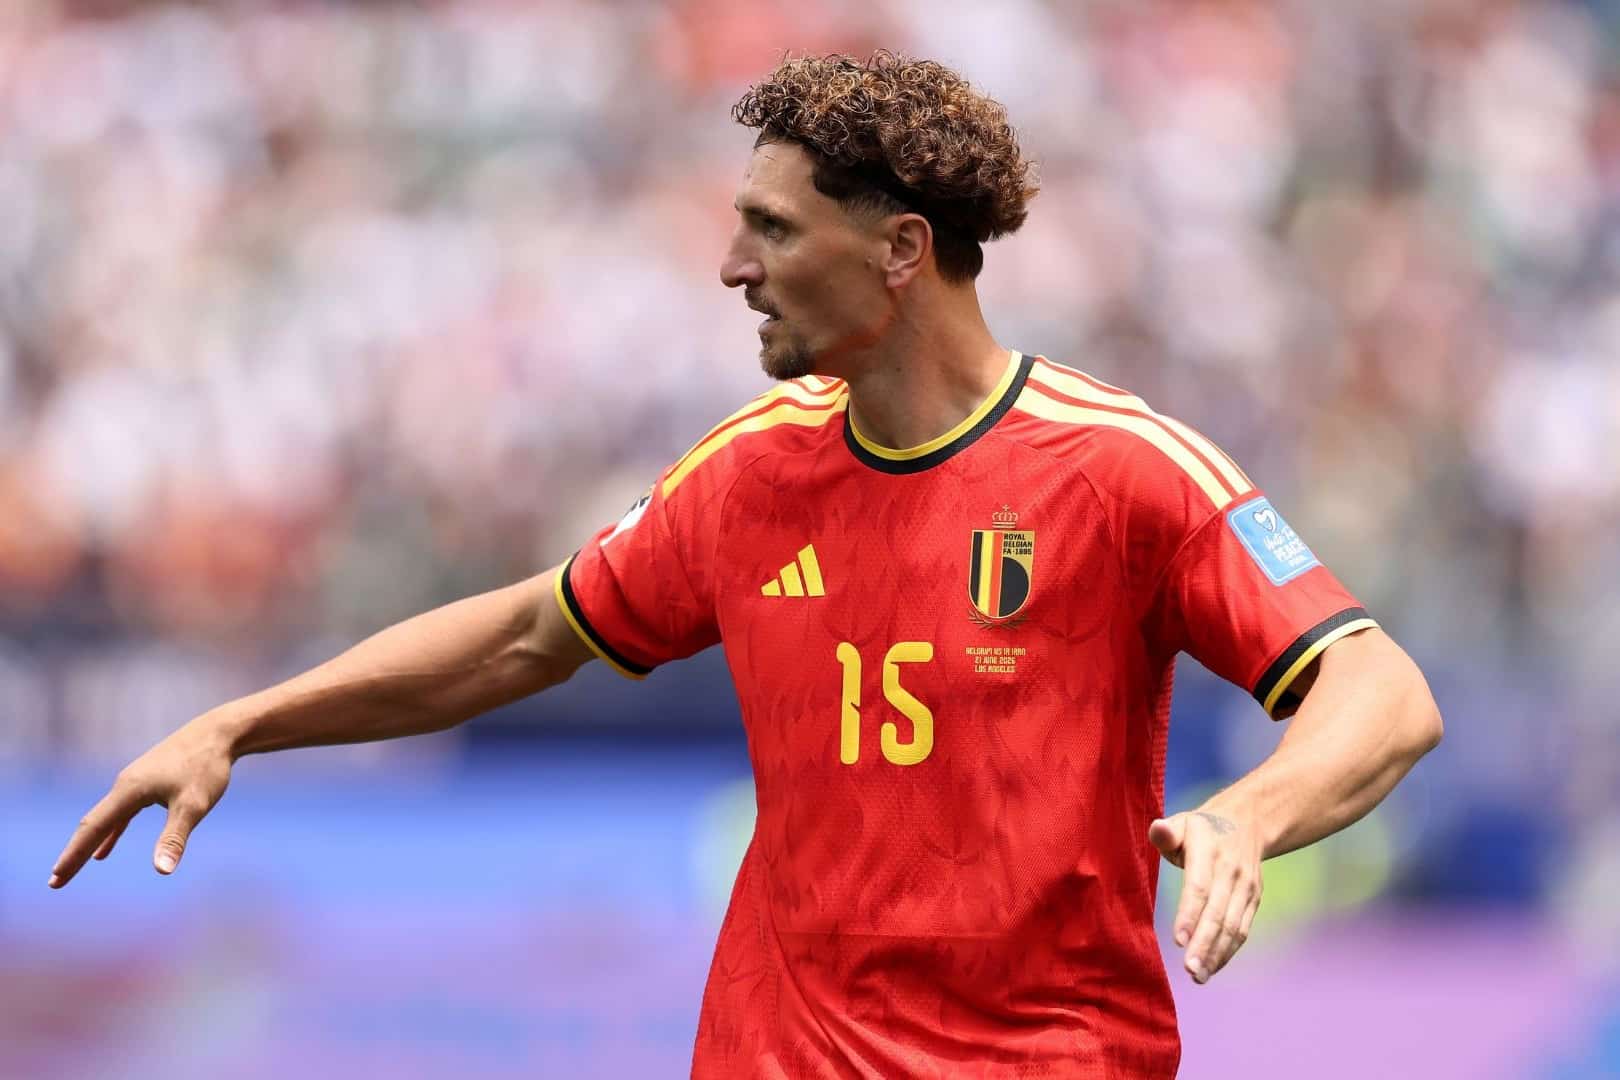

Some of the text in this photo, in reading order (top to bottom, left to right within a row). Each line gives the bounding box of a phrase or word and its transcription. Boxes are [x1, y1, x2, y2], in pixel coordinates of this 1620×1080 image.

[983, 656, 998, 665] JUNE
[974, 665, 1016, 673] LOS ANGELES
[836, 641, 934, 766] 15
